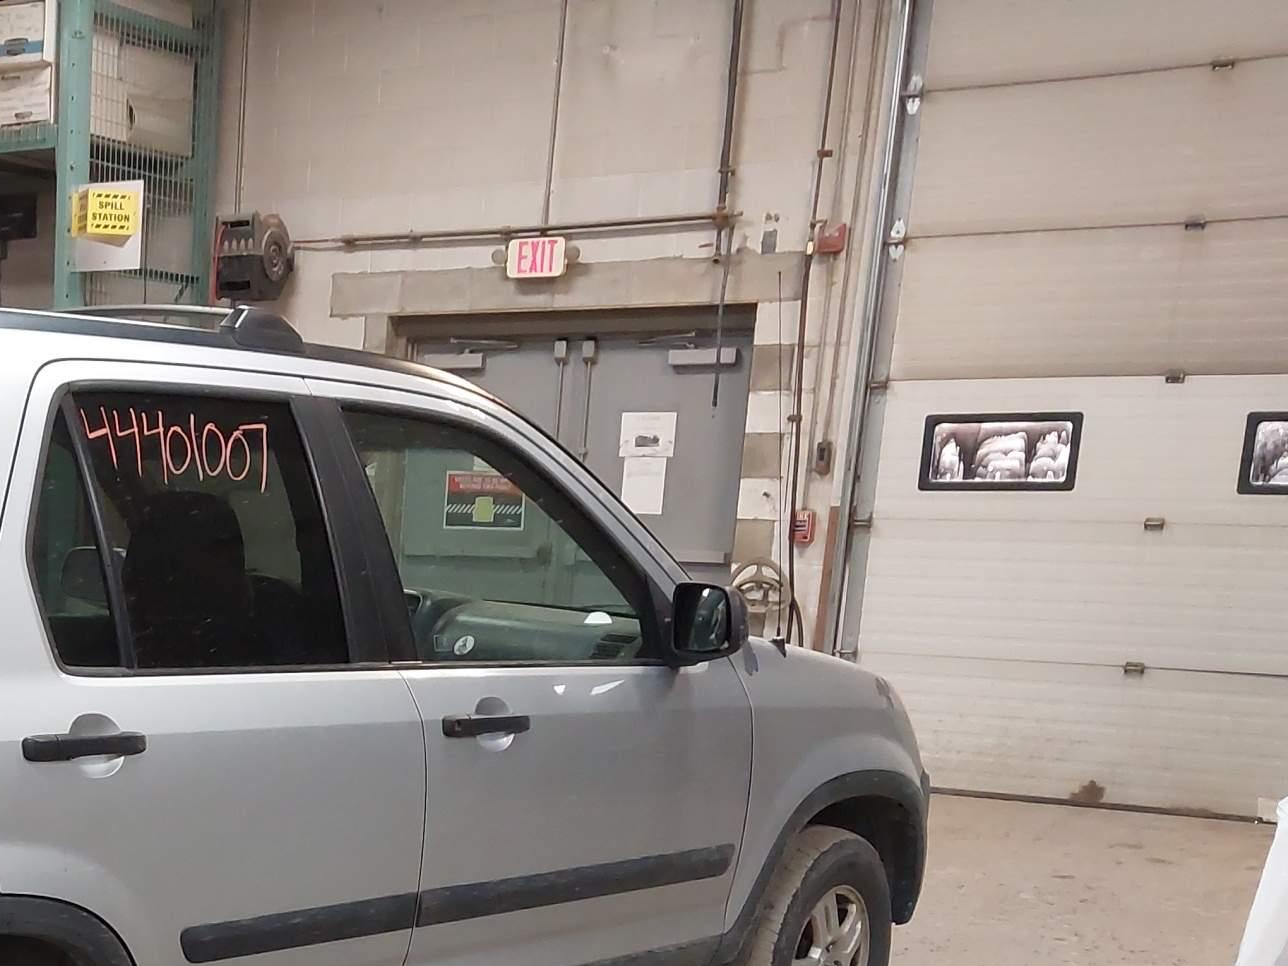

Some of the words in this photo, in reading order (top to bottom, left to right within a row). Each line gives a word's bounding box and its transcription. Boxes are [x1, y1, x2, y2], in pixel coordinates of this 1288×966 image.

[98, 201, 125, 211] SPILL
[92, 212, 130, 223] STATION
[517, 240, 558, 273] EXIT
[80, 406, 268, 494] 44401007
